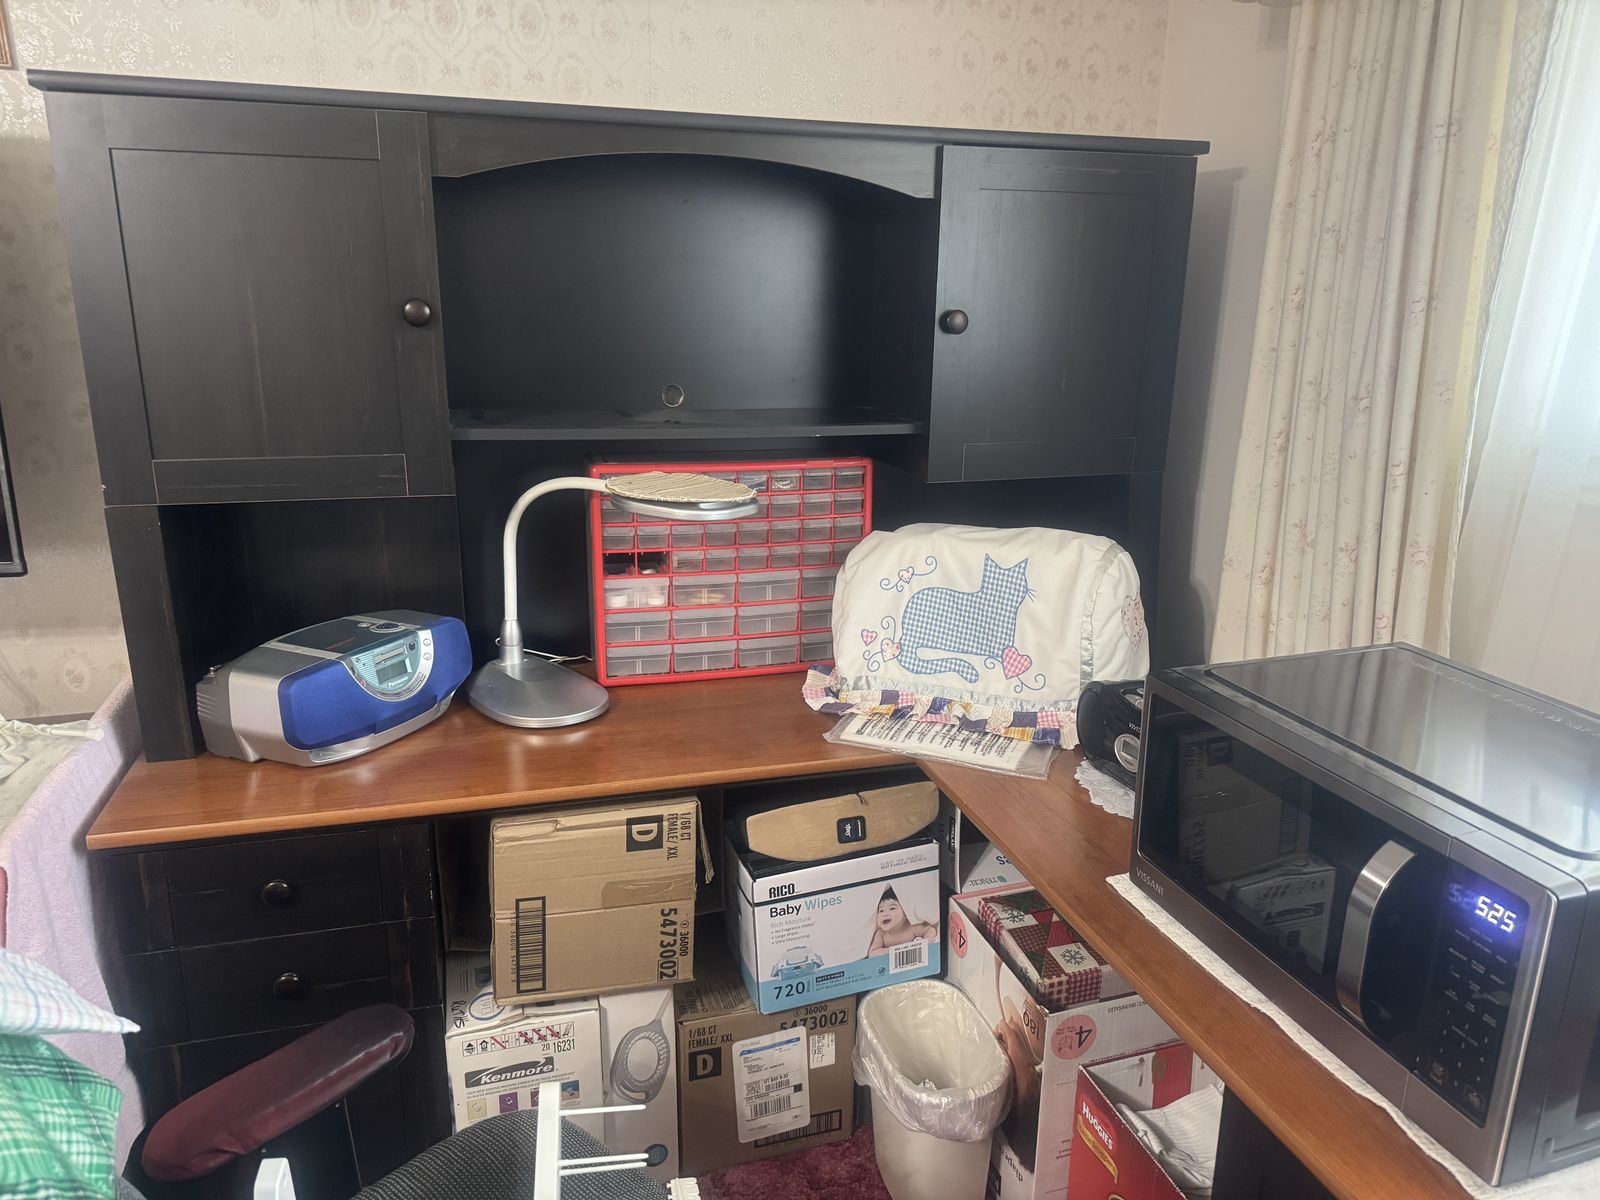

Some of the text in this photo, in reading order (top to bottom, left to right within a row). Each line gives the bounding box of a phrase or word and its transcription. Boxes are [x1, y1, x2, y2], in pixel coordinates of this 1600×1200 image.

[631, 822, 659, 843] D
[680, 833, 691, 842] CT
[666, 845, 678, 861] XXL
[768, 883, 795, 899] RICO
[1136, 866, 1164, 896] VISSANI
[769, 895, 843, 918] Baby Wipes
[658, 907, 678, 980] 5473002
[679, 931, 690, 957] 36000
[957, 928, 967, 949] 4
[773, 981, 806, 1000] 720
[804, 1004, 828, 1016] 36000
[688, 1025, 718, 1039] 1/68 CT
[1022, 1011, 1040, 1040] 180
[541, 1038, 575, 1053] 20 16231
[720, 1032, 734, 1043] XXL
[1074, 1025, 1093, 1049] 4
[480, 1064, 553, 1085] Kenmore
[697, 1053, 714, 1077] D
[1082, 1101, 1114, 1150] HUGGIES
